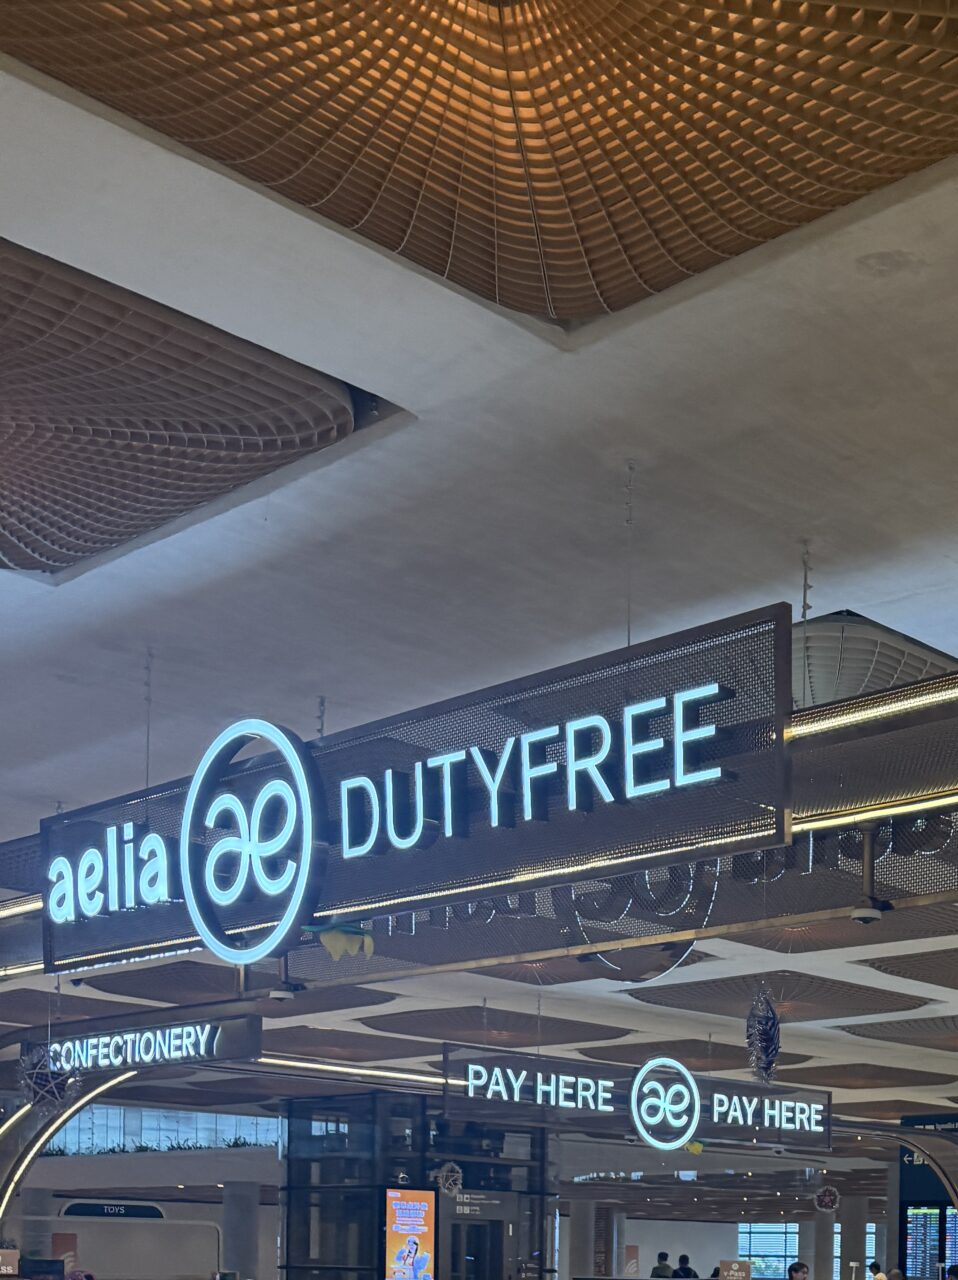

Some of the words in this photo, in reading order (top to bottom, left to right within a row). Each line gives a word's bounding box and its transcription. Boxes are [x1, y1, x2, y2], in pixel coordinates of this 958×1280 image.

[47, 823, 170, 925] aelia
[340, 682, 723, 859] DUTYFREE
[48, 1023, 212, 1072] CONFECTIONERY
[468, 1063, 527, 1102] PAY
[537, 1072, 615, 1112] HERE
[713, 1093, 758, 1126] PAY
[764, 1098, 825, 1133] HERE
[104, 1205, 125, 1214] TOYS
